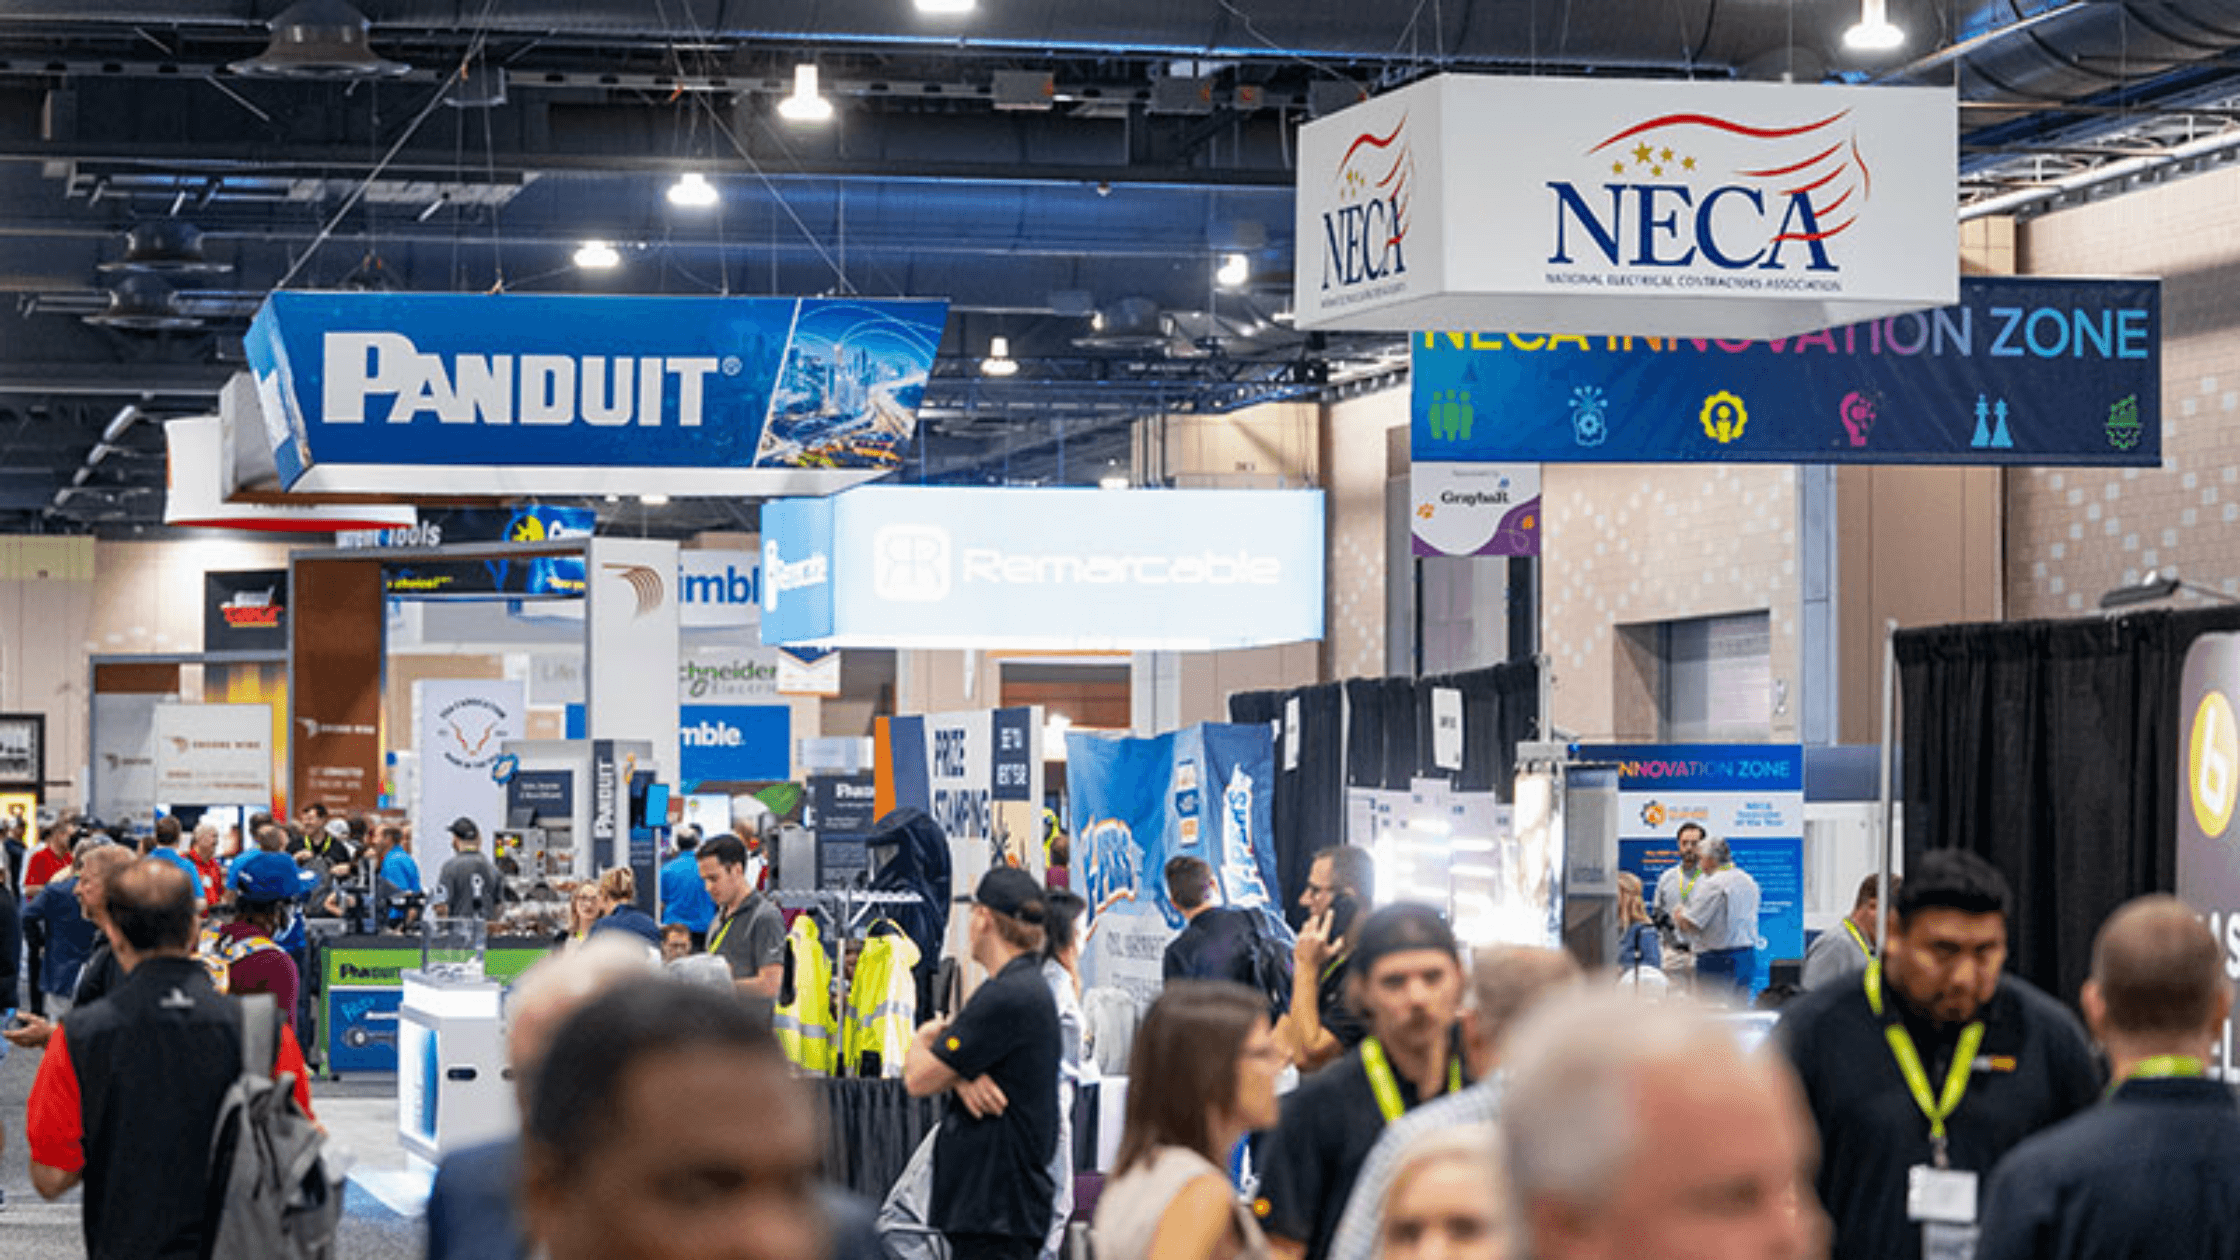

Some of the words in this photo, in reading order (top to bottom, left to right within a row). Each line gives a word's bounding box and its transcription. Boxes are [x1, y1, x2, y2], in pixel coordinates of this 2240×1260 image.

[1322, 199, 1406, 290] NECA
[1546, 181, 1841, 273] NECA
[1545, 273, 1602, 285] NATIONAL
[1607, 274, 1673, 287] ELECTRICAL
[1678, 275, 1761, 289] CONTRACTORS
[1766, 277, 1842, 291] ASSOCIATION
[1990, 307, 2148, 358] ZONE
[962, 546, 1281, 585] Remarcable
[1738, 760, 1791, 779] ZONE
